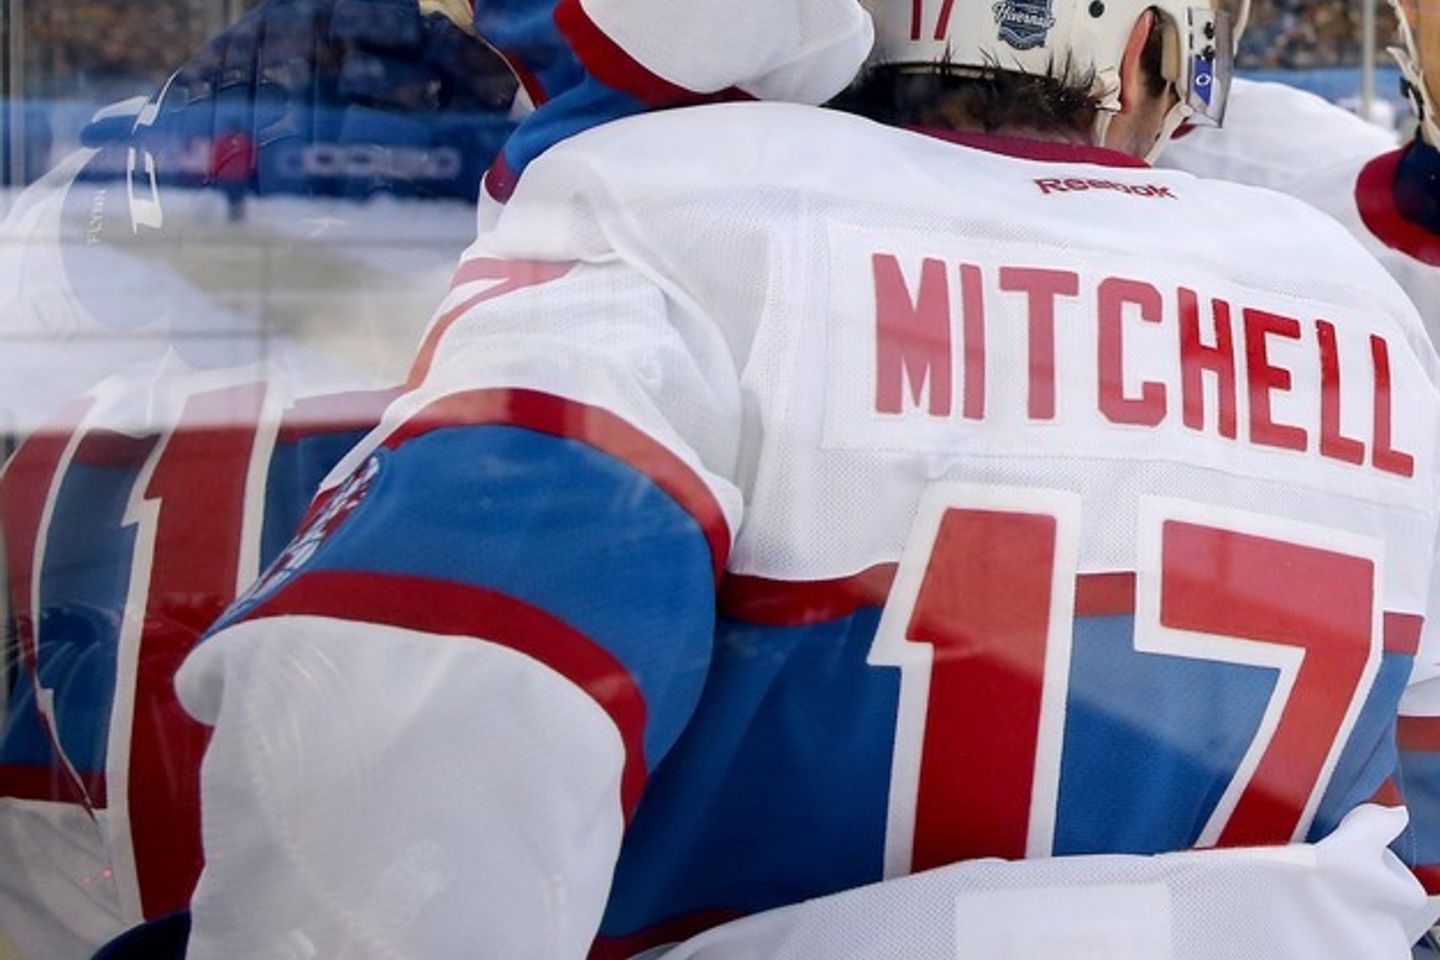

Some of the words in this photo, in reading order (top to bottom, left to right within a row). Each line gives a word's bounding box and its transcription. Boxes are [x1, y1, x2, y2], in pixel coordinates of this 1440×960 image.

[1033, 177, 1179, 201] Reebok
[872, 252, 1415, 478] MITCHELL
[868, 486, 1383, 886] 17
